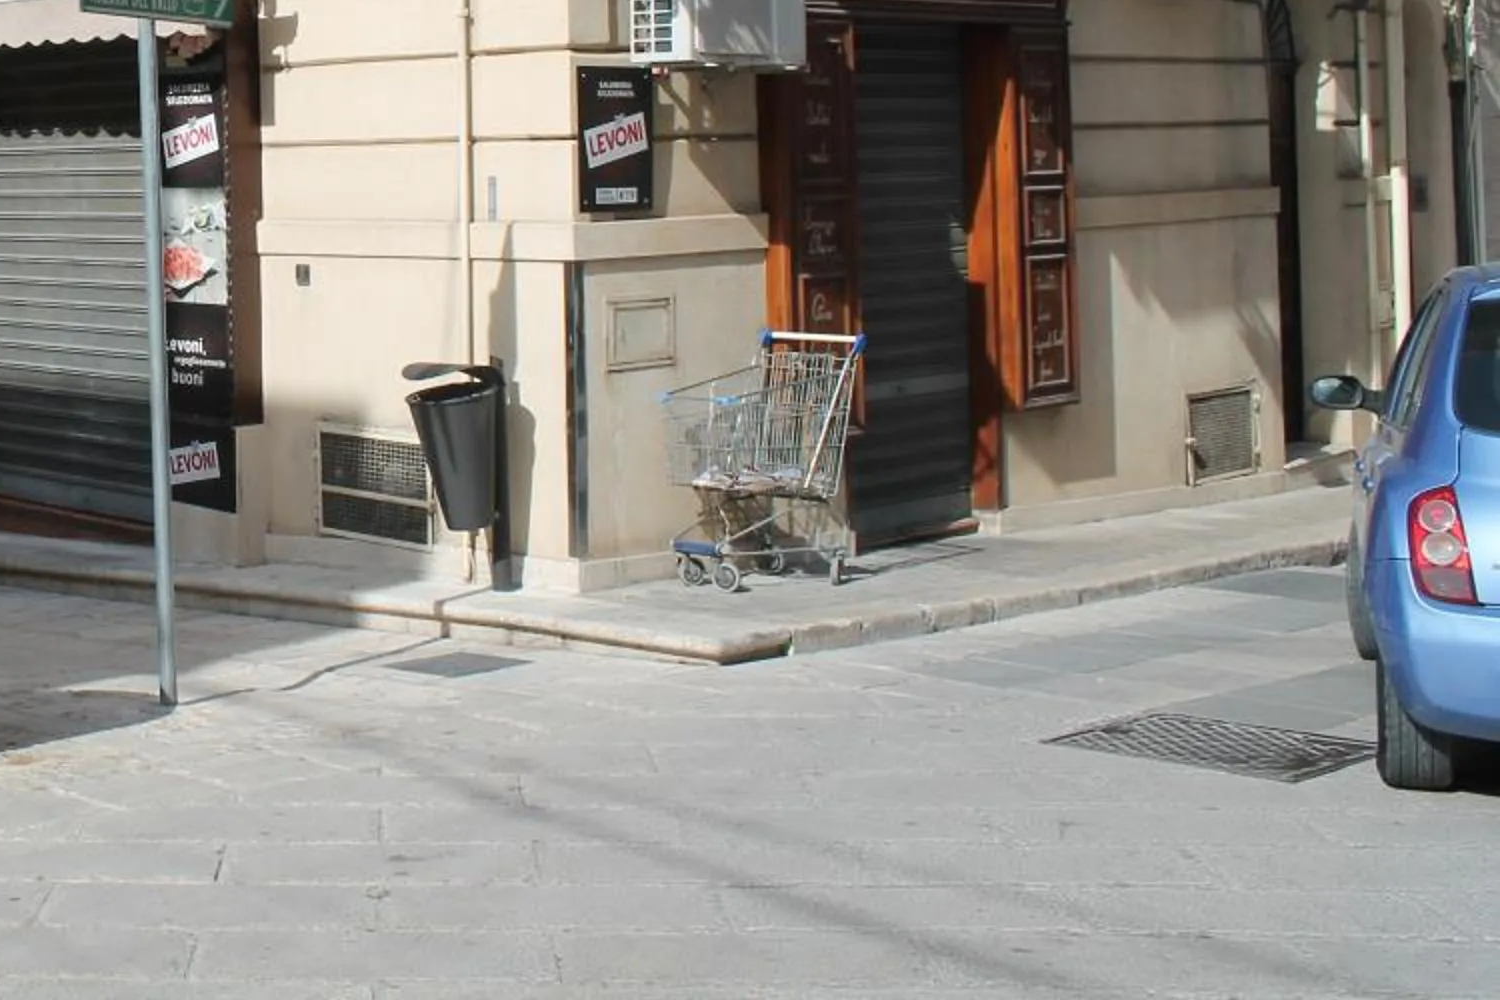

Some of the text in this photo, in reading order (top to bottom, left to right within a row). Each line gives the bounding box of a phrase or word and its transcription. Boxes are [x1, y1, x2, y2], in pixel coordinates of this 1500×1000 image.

[164, 122, 215, 159] LEVONI
[588, 119, 645, 157] LEVONI
[171, 367, 204, 386] buoni
[169, 448, 217, 475] LEVONI
